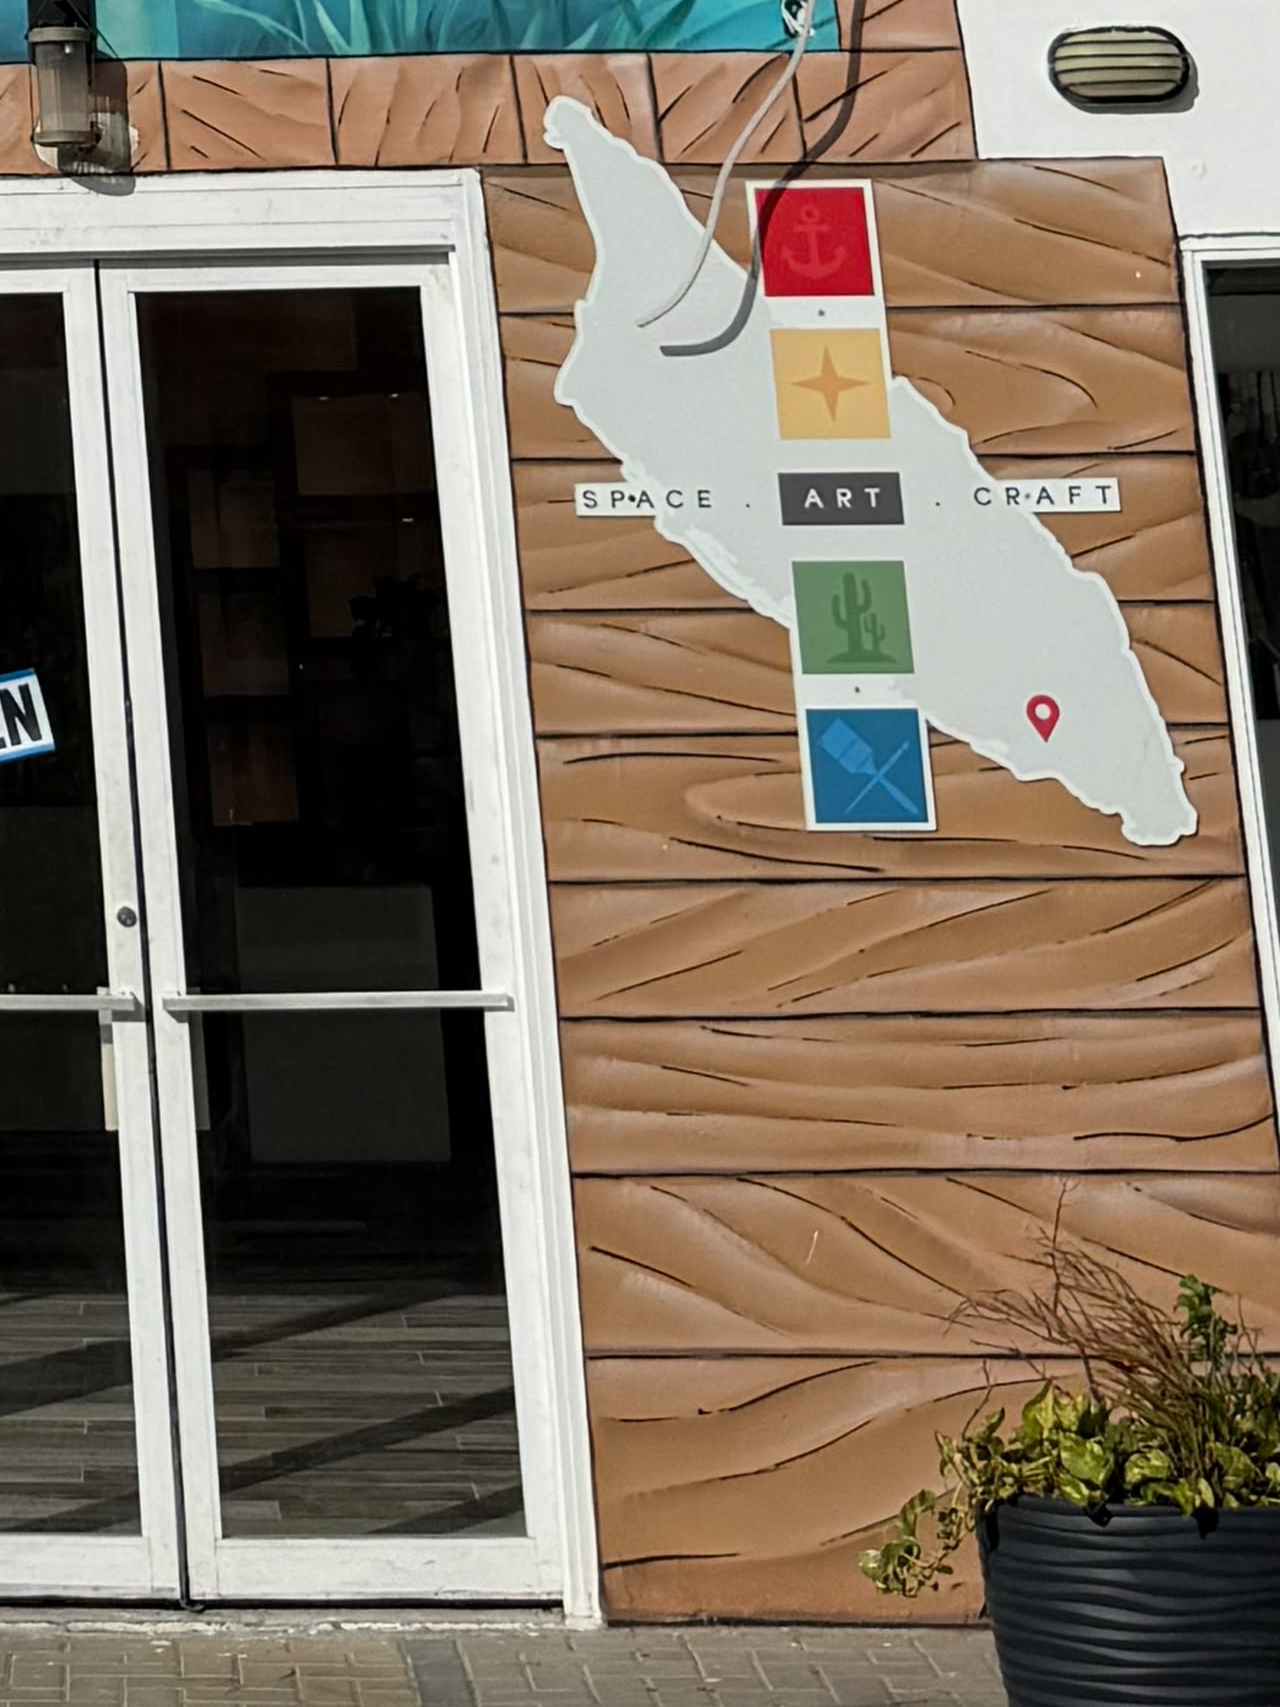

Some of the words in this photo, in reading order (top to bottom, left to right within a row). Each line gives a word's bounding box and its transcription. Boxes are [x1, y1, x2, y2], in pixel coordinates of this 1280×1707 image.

[581, 488, 713, 511] SPACE
[802, 488, 883, 510] ART
[973, 483, 1114, 508] CRAFT
